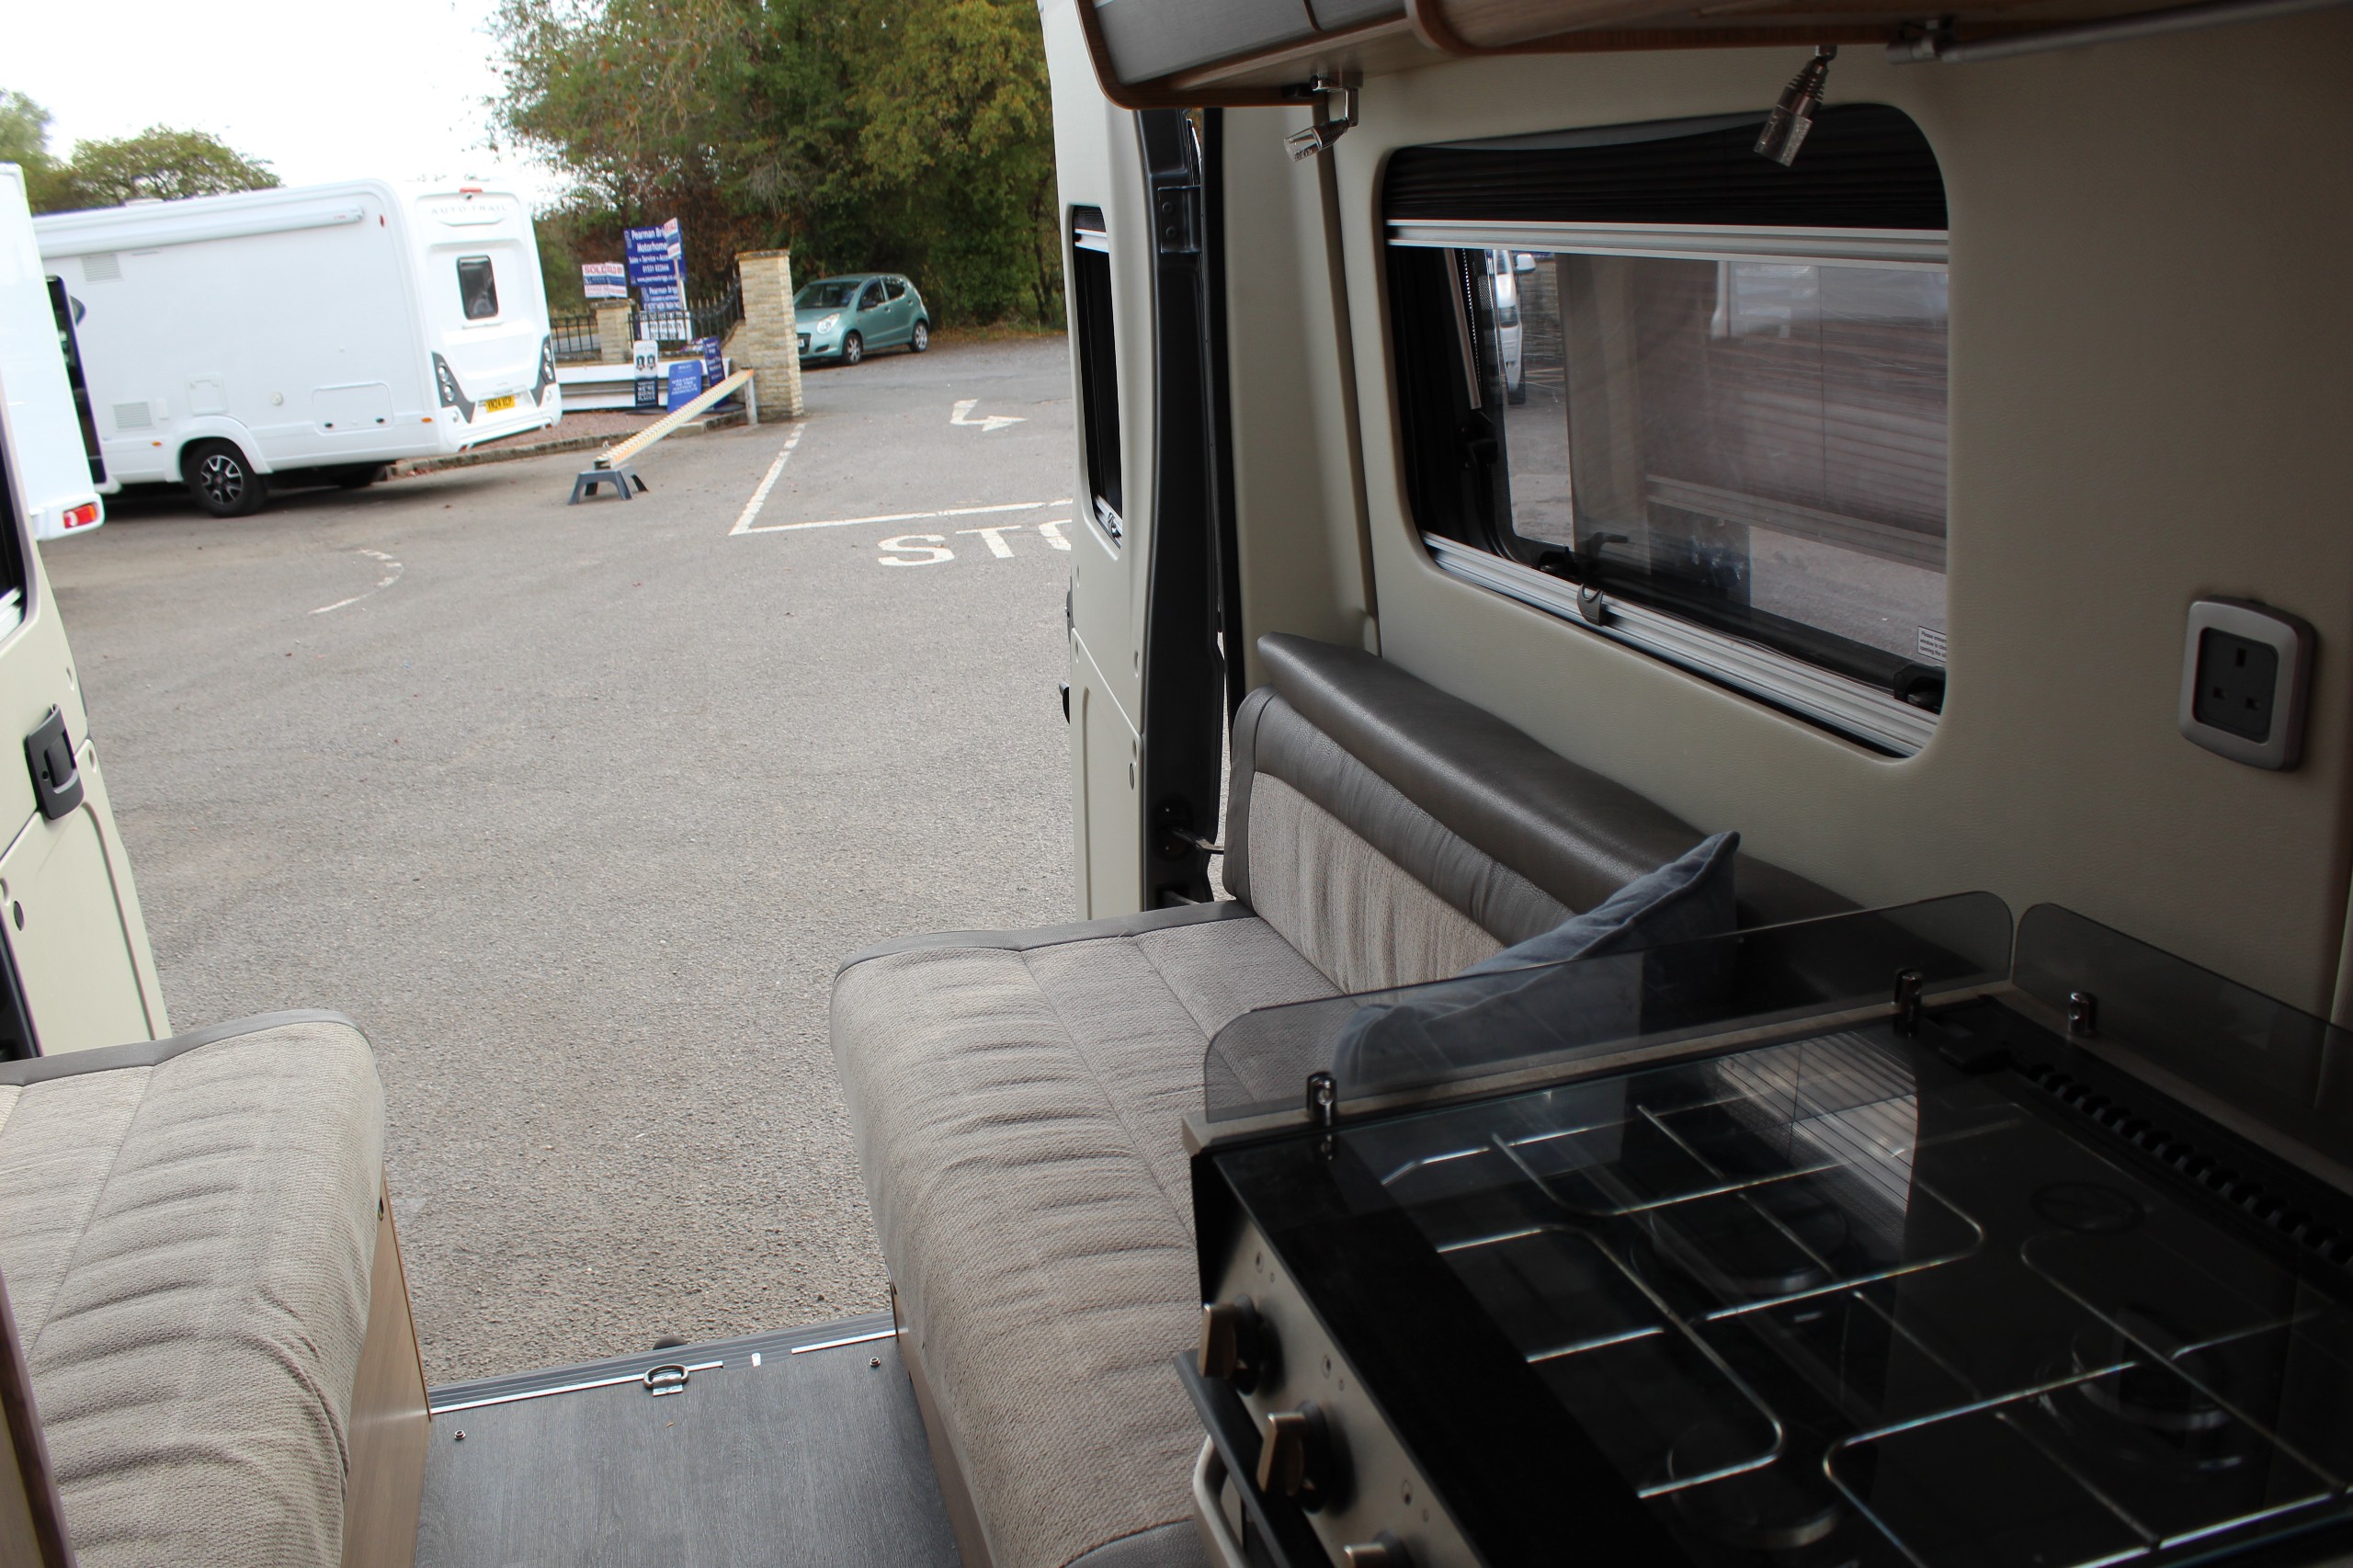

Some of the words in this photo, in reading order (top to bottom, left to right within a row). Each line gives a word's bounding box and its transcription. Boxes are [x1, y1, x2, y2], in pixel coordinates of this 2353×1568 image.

[631, 229, 655, 240] Pearman
[637, 241, 667, 254] Motorhome
[878, 519, 1072, 566] ST
